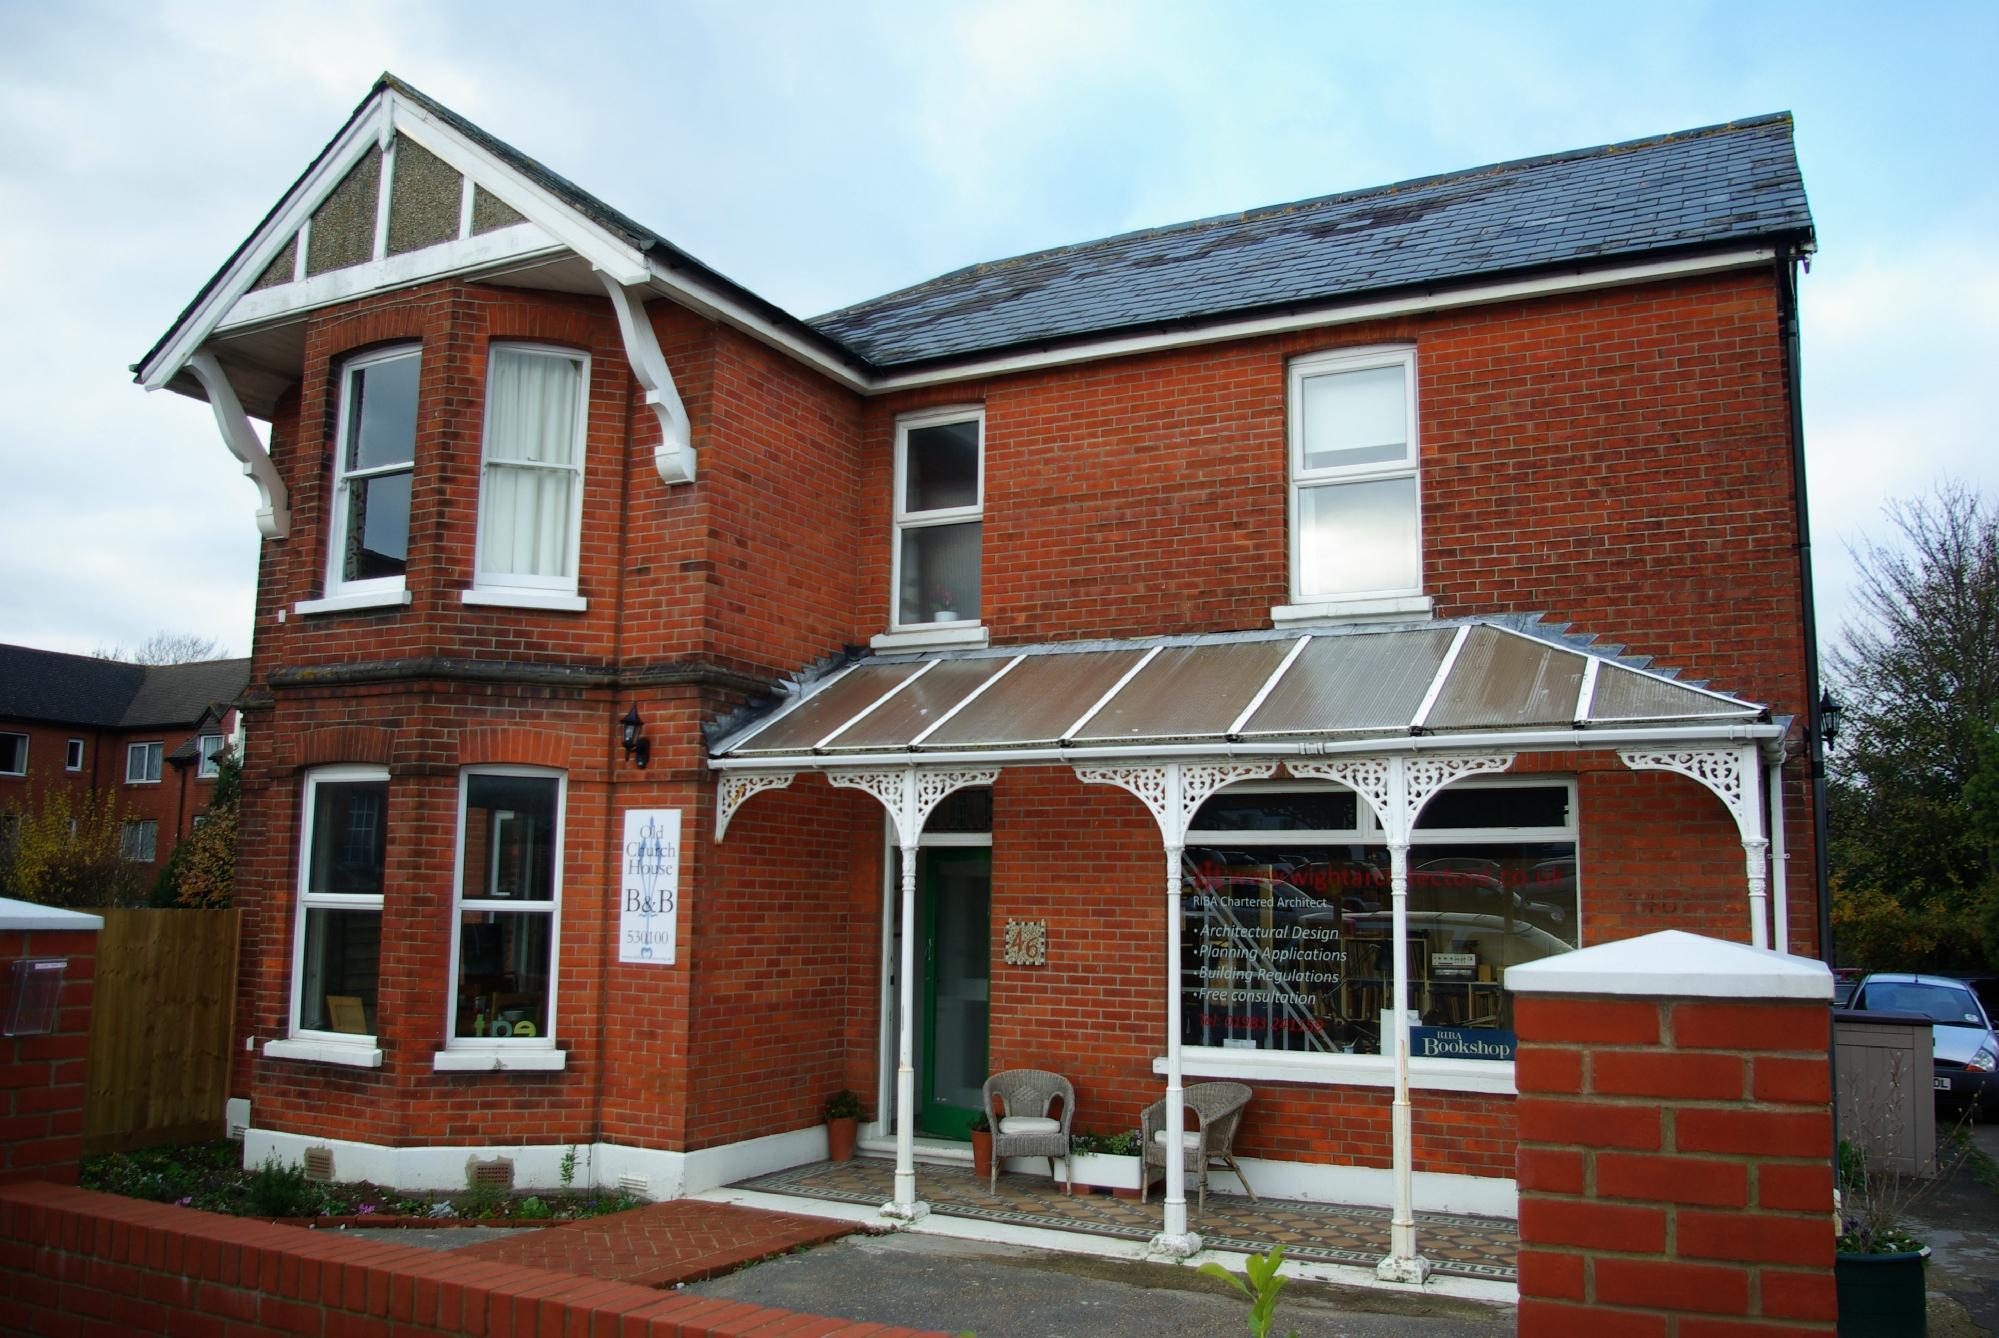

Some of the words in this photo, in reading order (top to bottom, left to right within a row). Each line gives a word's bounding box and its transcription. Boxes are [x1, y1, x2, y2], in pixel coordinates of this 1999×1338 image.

[640, 825, 664, 840] Old
[626, 841, 676, 858] Church
[628, 859, 673, 876] House
[625, 888, 674, 914] B&B
[1193, 896, 1218, 907] RIBA
[1220, 896, 1274, 907] Chartered
[1277, 896, 1328, 908] Architect
[626, 930, 670, 945] 530100
[1199, 924, 1288, 939] Architectural
[1291, 925, 1339, 942] Design
[1010, 928, 1039, 958] 46
[1199, 944, 1258, 960] Planning
[1261, 946, 1347, 962] Applications
[1199, 966, 1254, 982] Building
[1257, 968, 1340, 984] Regulations
[1199, 987, 1228, 1000] Free
[1231, 990, 1316, 1005] consultation
[1436, 1031, 1462, 1040] RIBA
[1422, 1037, 1510, 1059] Bookshop
